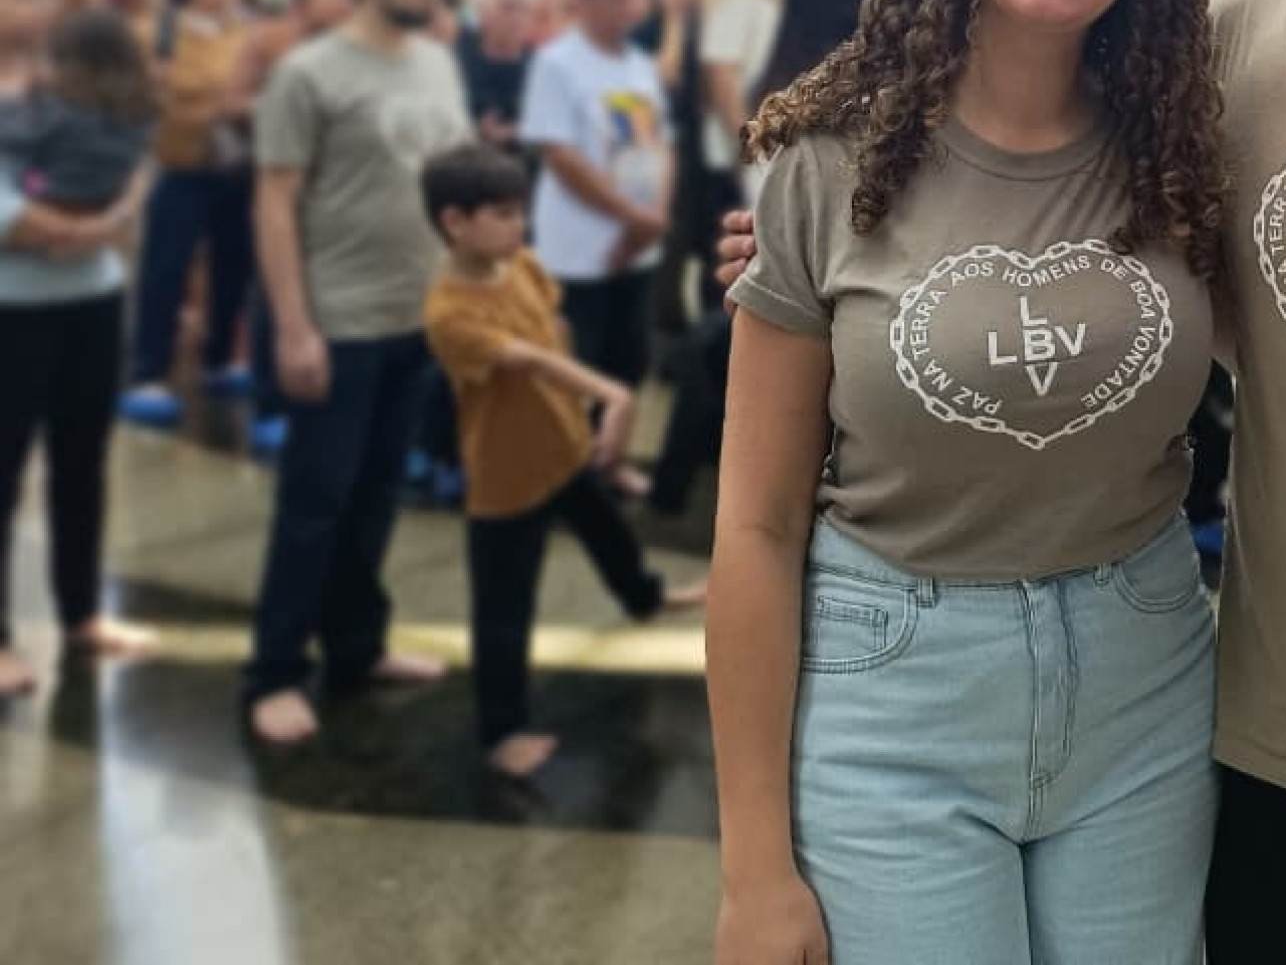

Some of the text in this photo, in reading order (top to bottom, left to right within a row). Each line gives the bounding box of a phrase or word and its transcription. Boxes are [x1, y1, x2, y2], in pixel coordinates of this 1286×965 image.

[950, 262, 994, 286] AOS
[1002, 254, 1091, 287] HOMENS
[1100, 258, 1127, 280] DE
[910, 289, 947, 360] TERRA
[923, 359, 954, 390] NA
[1080, 326, 1156, 407] VONTADE
[952, 386, 1003, 415] PAZ
